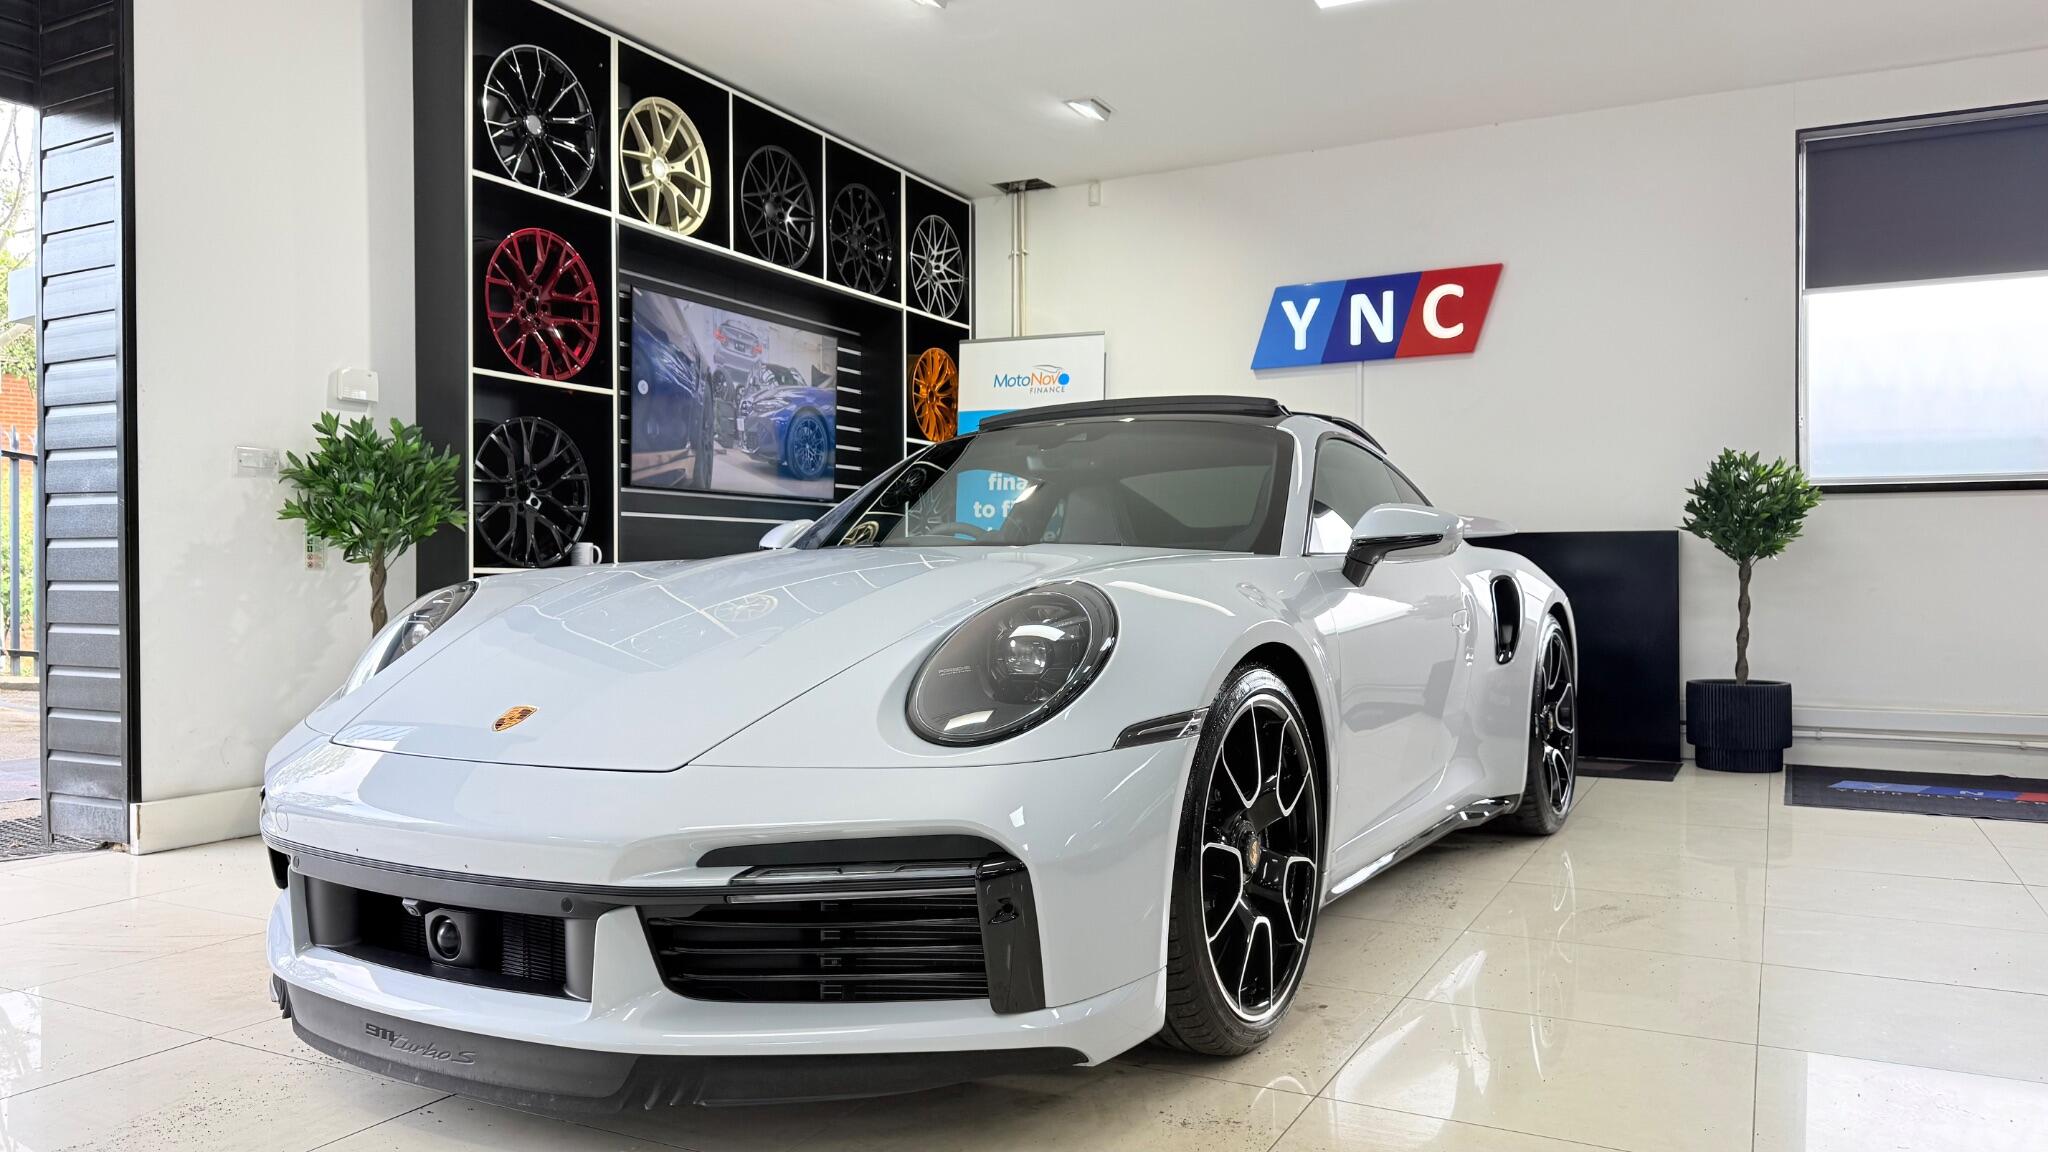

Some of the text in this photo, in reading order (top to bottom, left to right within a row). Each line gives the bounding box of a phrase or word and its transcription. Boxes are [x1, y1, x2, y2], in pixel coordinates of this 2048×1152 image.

[1281, 283, 1464, 351] YNC
[1030, 386, 1066, 395] FINANCE
[973, 501, 996, 518] to
[451, 1051, 477, 1065] S
